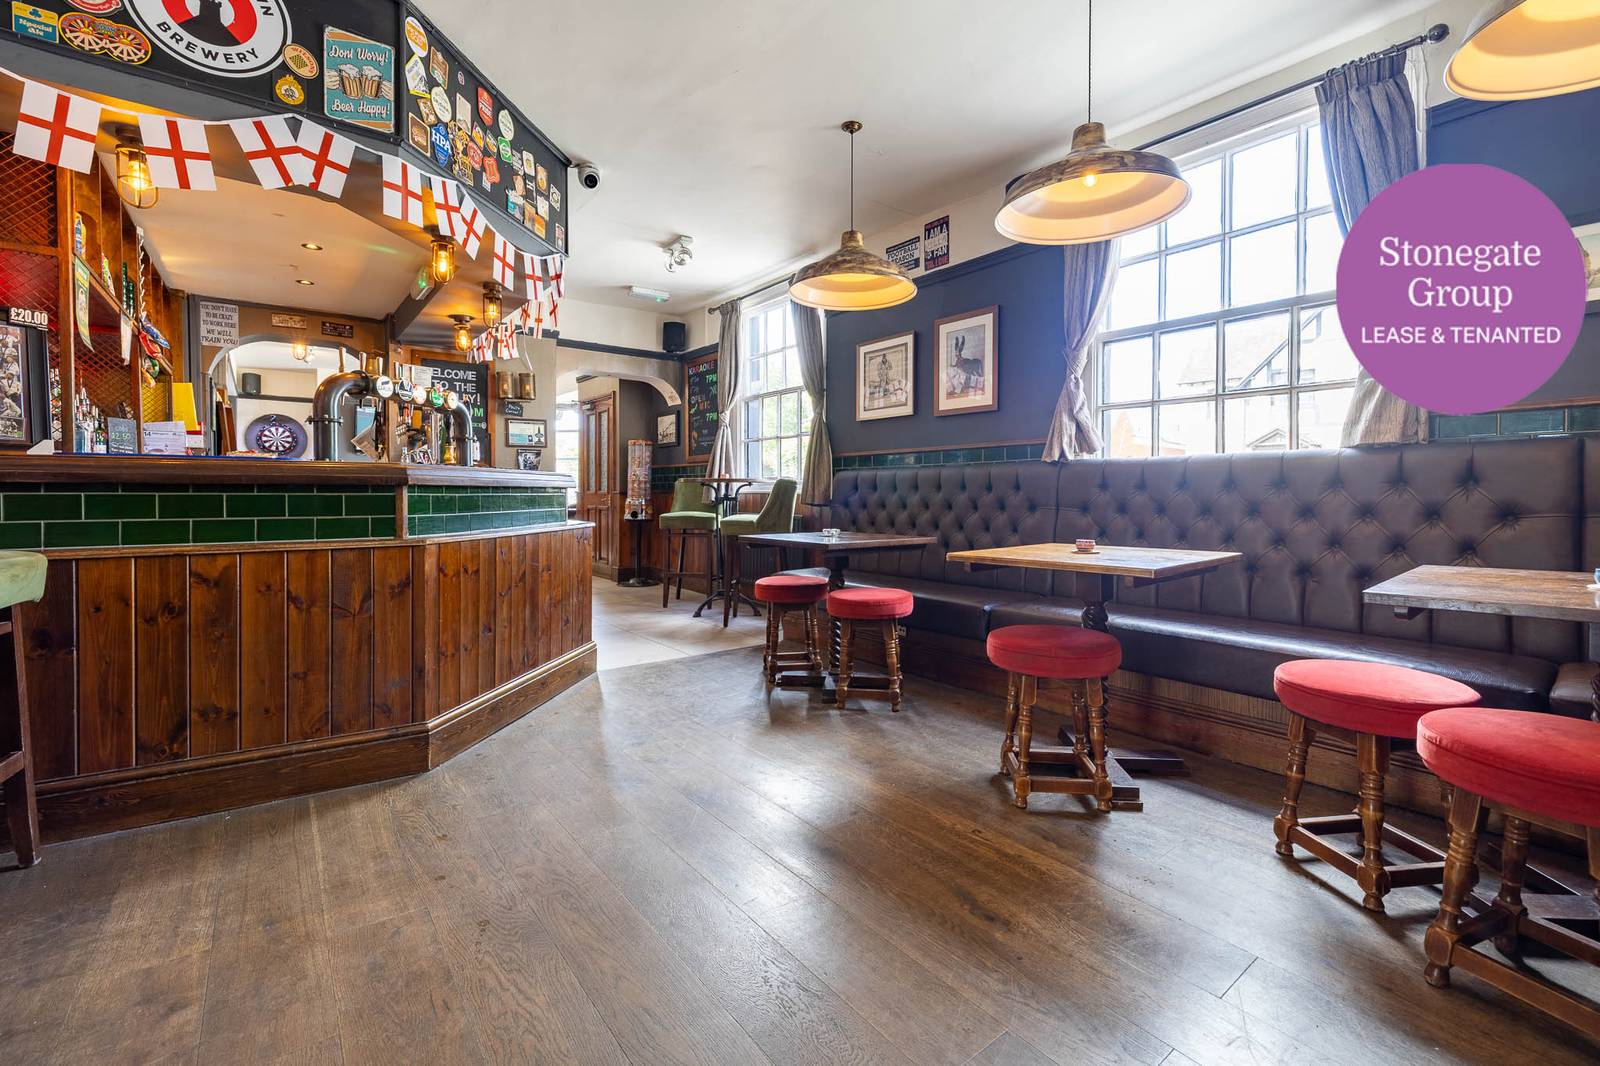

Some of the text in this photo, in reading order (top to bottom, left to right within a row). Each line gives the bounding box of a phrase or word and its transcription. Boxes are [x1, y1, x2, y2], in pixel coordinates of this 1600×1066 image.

[156, 21, 259, 64] BREWERY
[356, 47, 389, 67] Worry!
[331, 98, 390, 119] Beer Happy!
[431, 130, 451, 154] HPA
[887, 243, 919, 260] FOOTBALL
[10, 307, 49, 326] £20.00
[432, 367, 477, 381] ELCOME
[453, 382, 477, 392] THE
